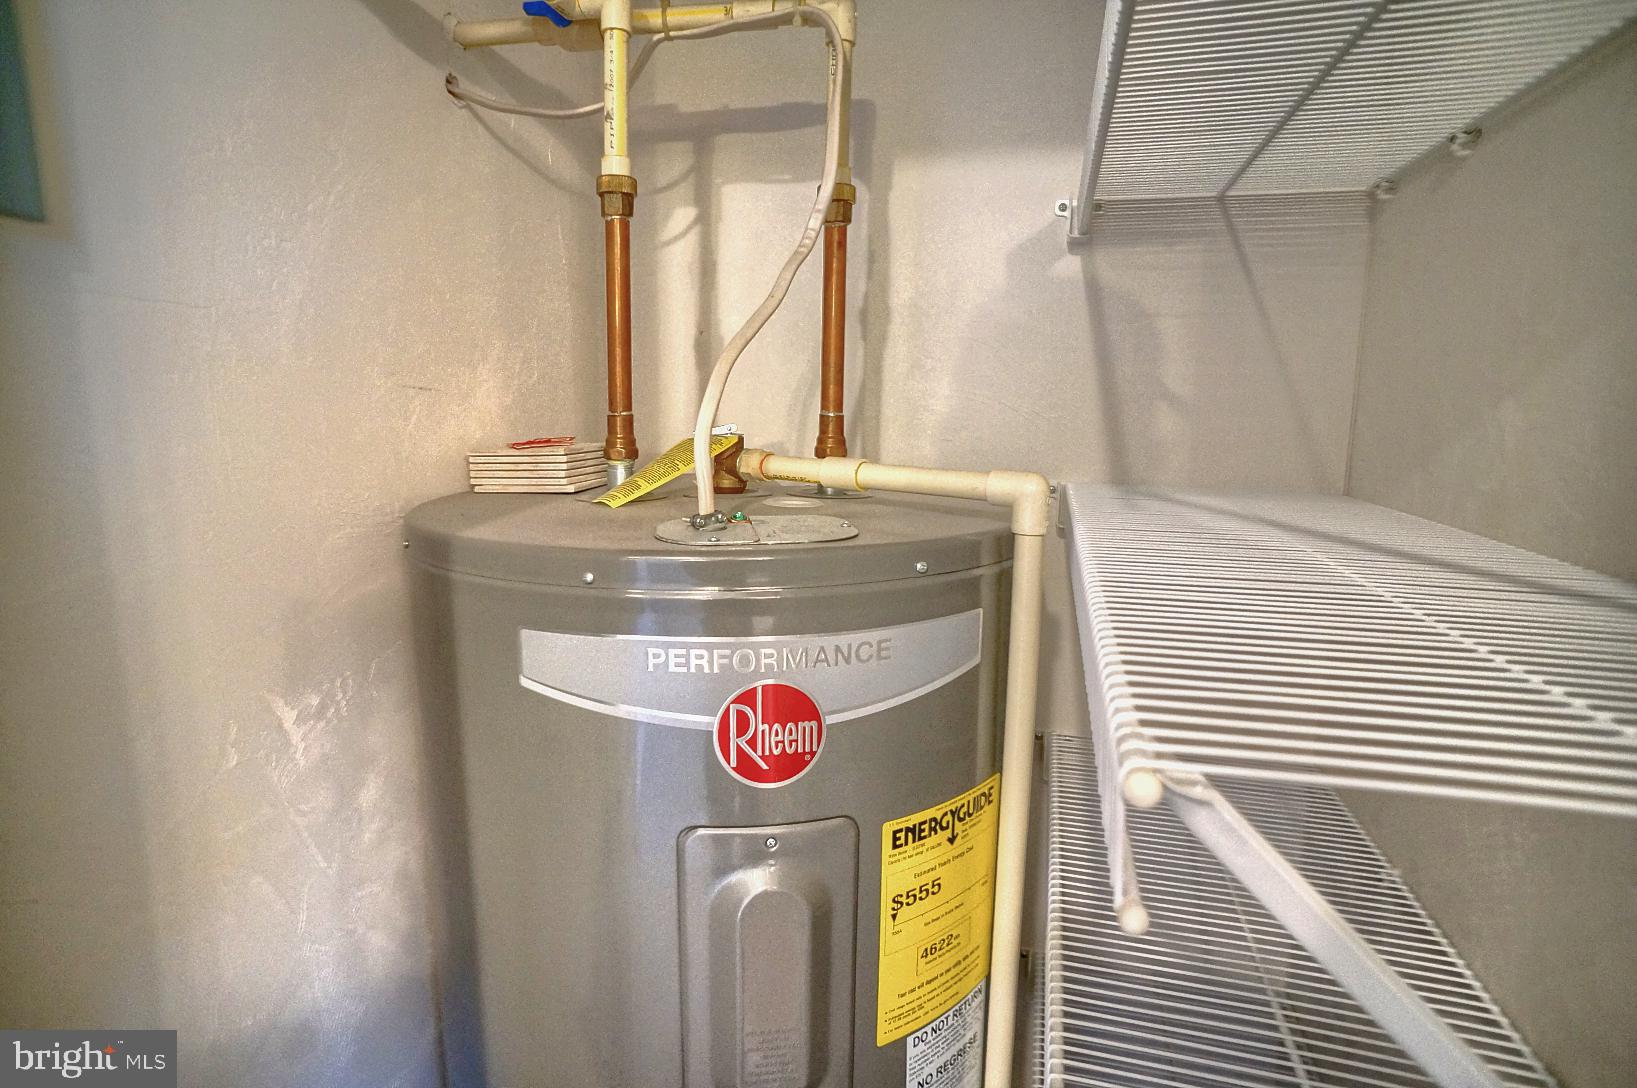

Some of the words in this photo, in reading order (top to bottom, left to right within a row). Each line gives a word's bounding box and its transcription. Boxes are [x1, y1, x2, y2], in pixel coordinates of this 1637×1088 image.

[646, 638, 893, 675] PERFORMANCE
[729, 686, 818, 770] Rheem
[891, 785, 995, 850] ENERGYGUIDE
[891, 877, 942, 912] $555
[920, 933, 954, 960] 4622
[912, 1031, 929, 1048] DO
[930, 1015, 950, 1040] NOT
[916, 1072, 934, 1088] NO
